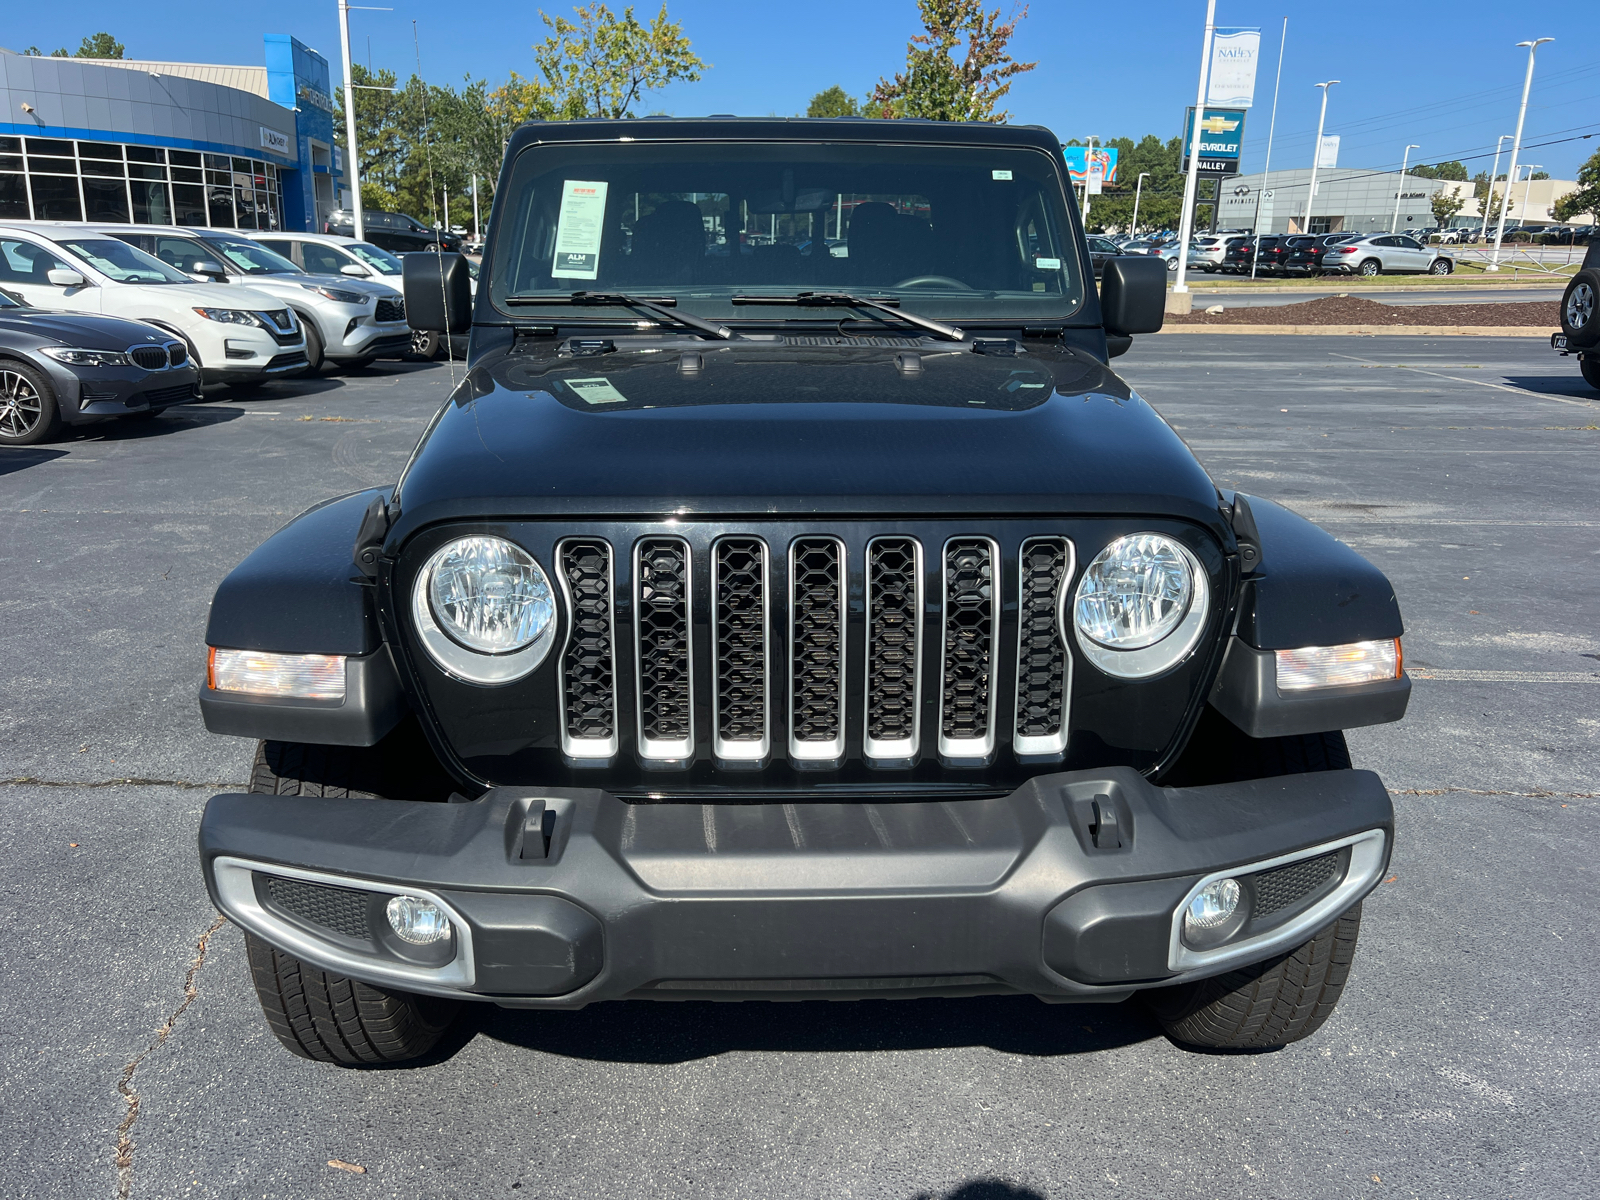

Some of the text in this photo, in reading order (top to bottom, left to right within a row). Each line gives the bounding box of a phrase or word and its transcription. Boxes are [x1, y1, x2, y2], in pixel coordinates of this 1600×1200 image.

[1218, 47, 1255, 58] NALLEY
[1196, 161, 1226, 171] NALLEY
[567, 253, 586, 261] ALM
